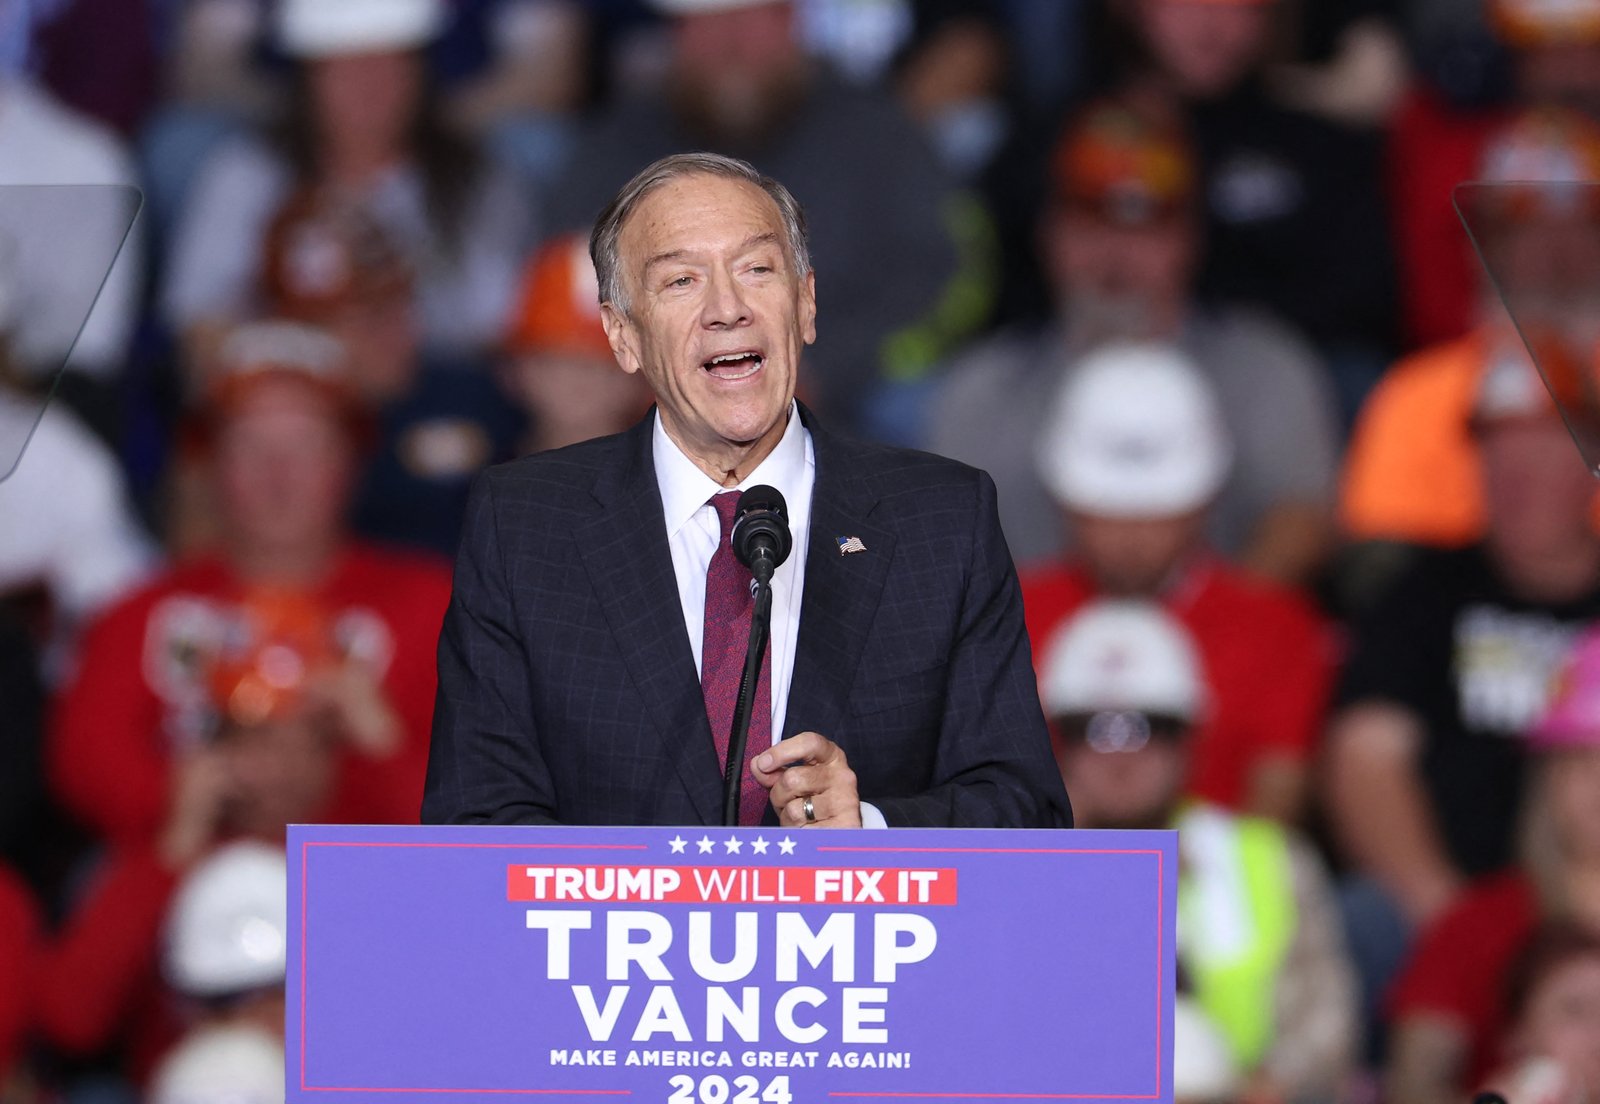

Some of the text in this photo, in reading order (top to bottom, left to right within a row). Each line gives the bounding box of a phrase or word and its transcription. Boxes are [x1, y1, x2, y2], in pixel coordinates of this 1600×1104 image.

[526, 867, 938, 903] TRUMP WILL FIX IT
[525, 909, 938, 983] TRUMP
[571, 984, 889, 1043] VANCE
[550, 1049, 911, 1069] MAKE AMERICA GREAT AGAIN!
[667, 1074, 793, 1104] 2024
